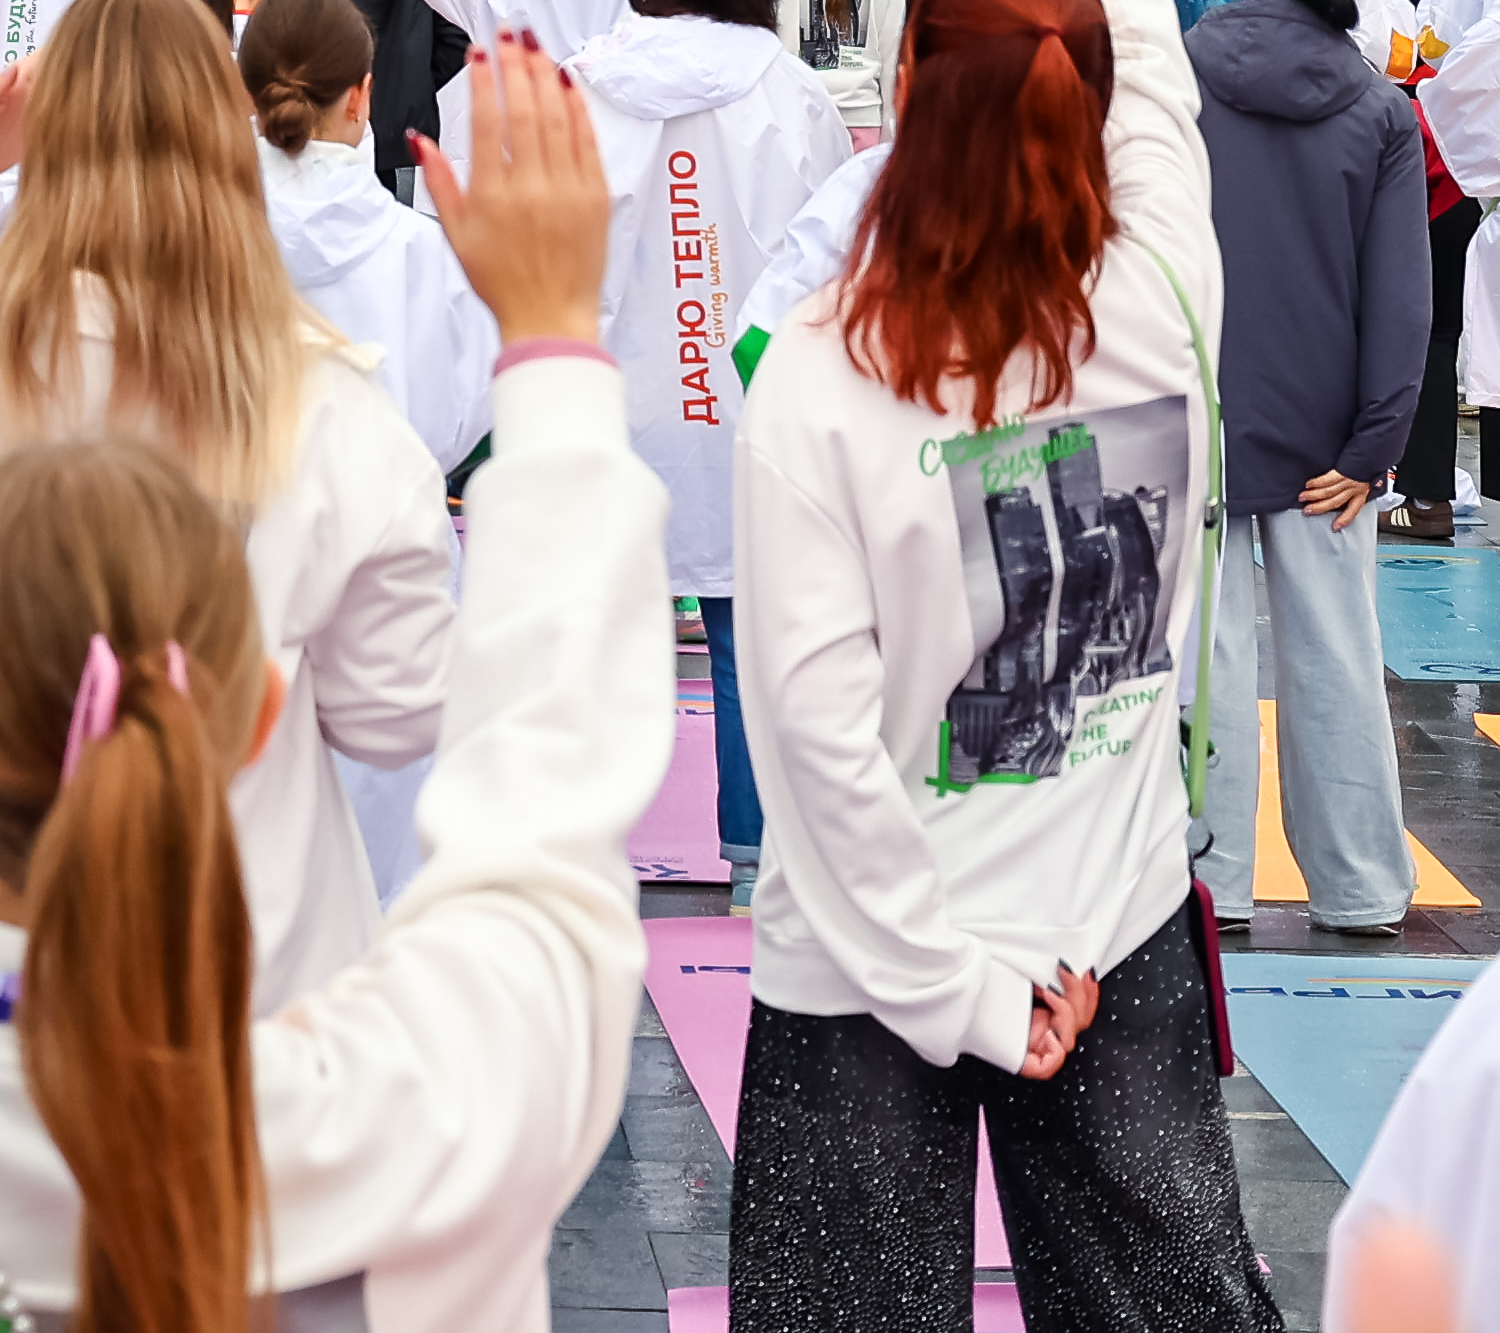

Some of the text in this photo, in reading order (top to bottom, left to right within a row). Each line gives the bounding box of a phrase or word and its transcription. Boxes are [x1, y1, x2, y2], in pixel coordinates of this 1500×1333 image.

[668, 150, 720, 425] ДАРЮ ТЕПЛО
[701, 223, 728, 348] Giving warmth
